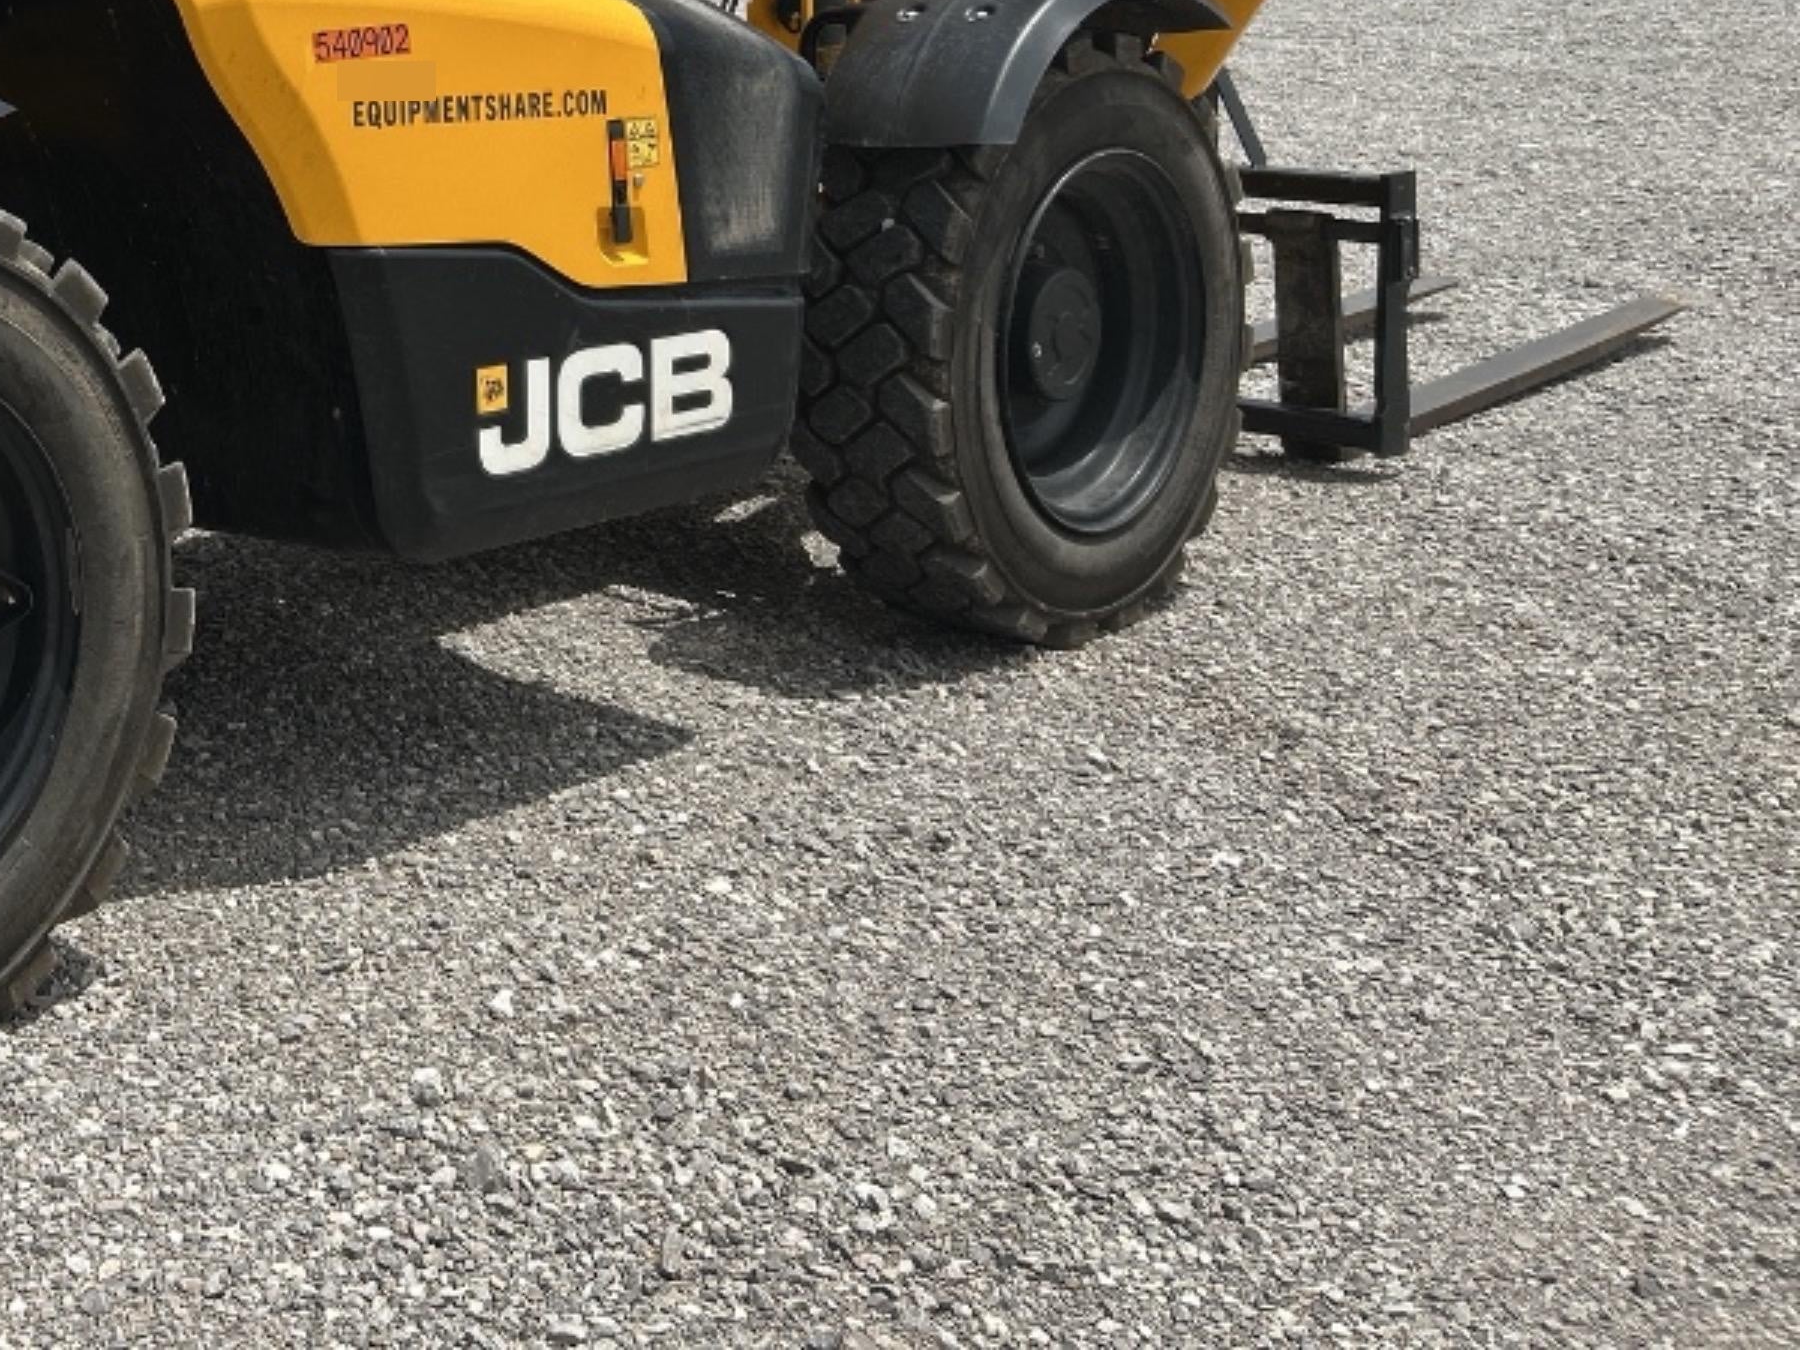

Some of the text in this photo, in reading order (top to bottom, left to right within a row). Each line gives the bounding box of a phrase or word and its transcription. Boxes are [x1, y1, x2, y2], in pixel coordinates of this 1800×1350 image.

[316, 24, 410, 62] 540902
[353, 90, 607, 130] EQUIPMENTSHARE.COM
[479, 329, 733, 475] JCB
